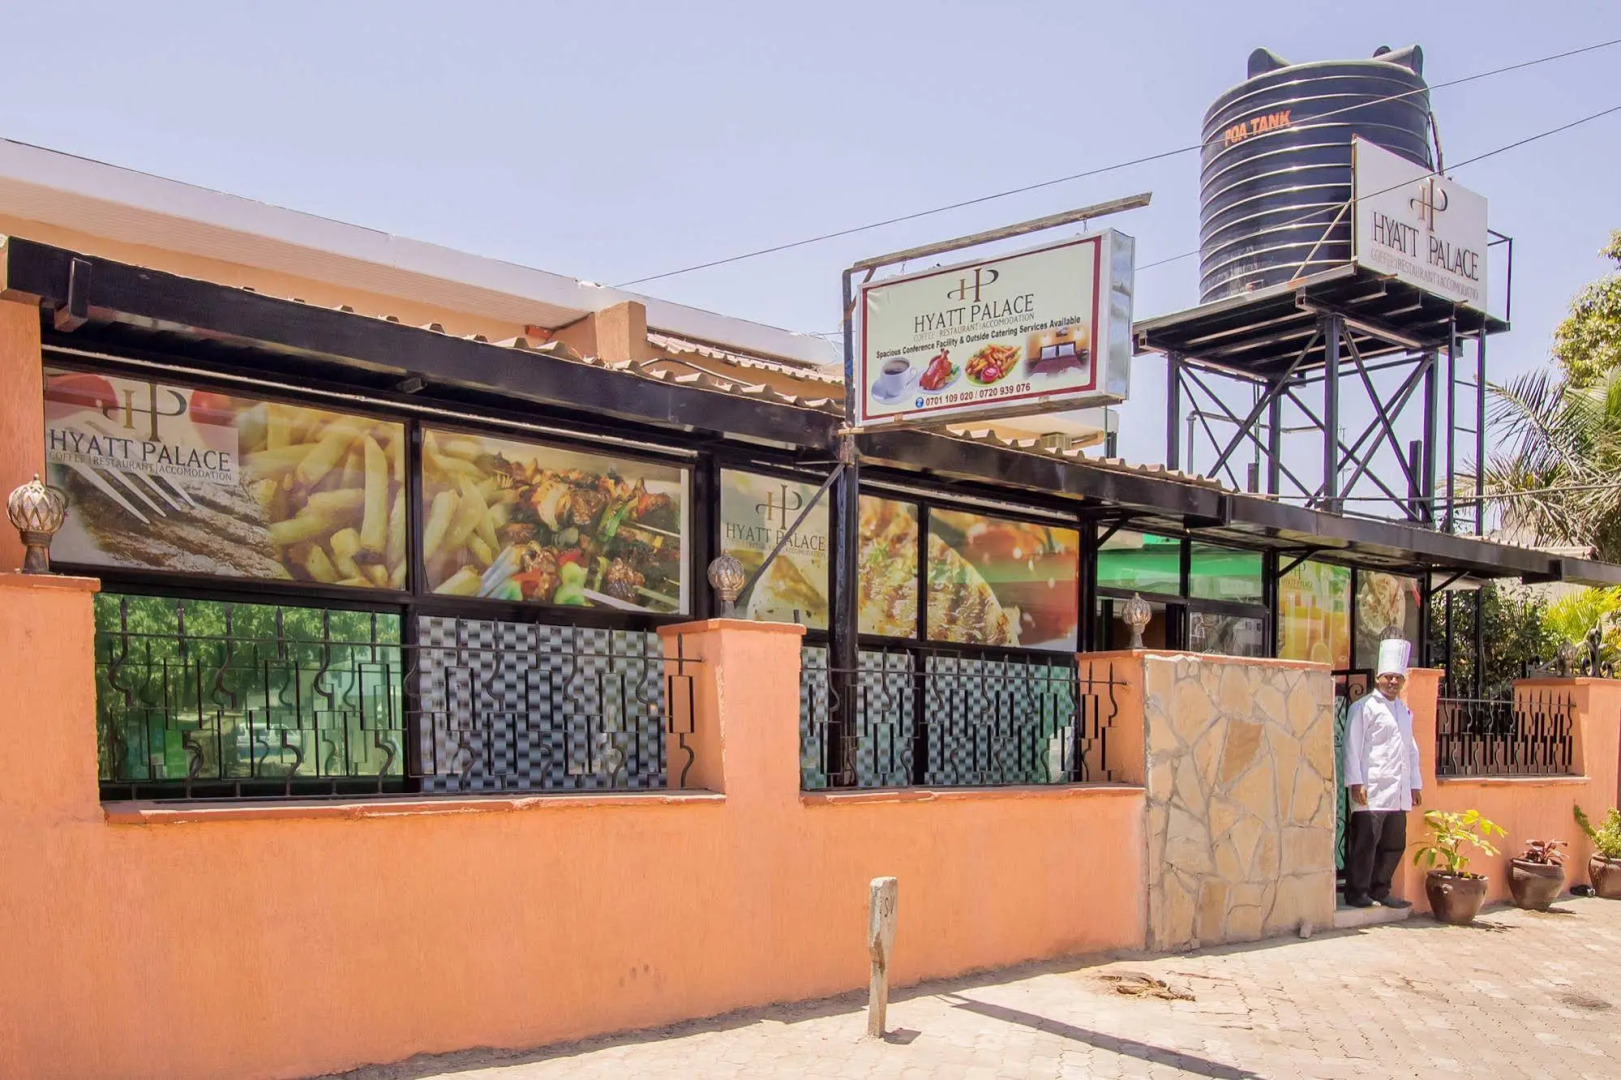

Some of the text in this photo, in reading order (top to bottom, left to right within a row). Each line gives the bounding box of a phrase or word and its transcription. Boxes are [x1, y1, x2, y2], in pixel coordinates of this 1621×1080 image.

[1225, 109, 1292, 148] POA TANK
[1373, 211, 1479, 282] HYATT PALACE
[1397, 258, 1437, 285] RESTAURANT
[913, 312, 1035, 342] COFFEE RESTAURANT ACCOMODATION
[914, 293, 1034, 334] HYATT PALACE
[876, 315, 1081, 360] Spacious Conference Facility & Outside Catering Services Available
[925, 396, 943, 406] 0701
[945, 393, 958, 403] 109
[960, 391, 974, 401] 020
[979, 388, 998, 398] 0720
[1000, 385, 1014, 396] 939
[1016, 382, 1031, 393] 076
[50, 428, 231, 472] HYATT PALACE
[50, 451, 232, 481] COFFEE RESTAURANT ACCOMODATION
[726, 522, 771, 544] HYATT
